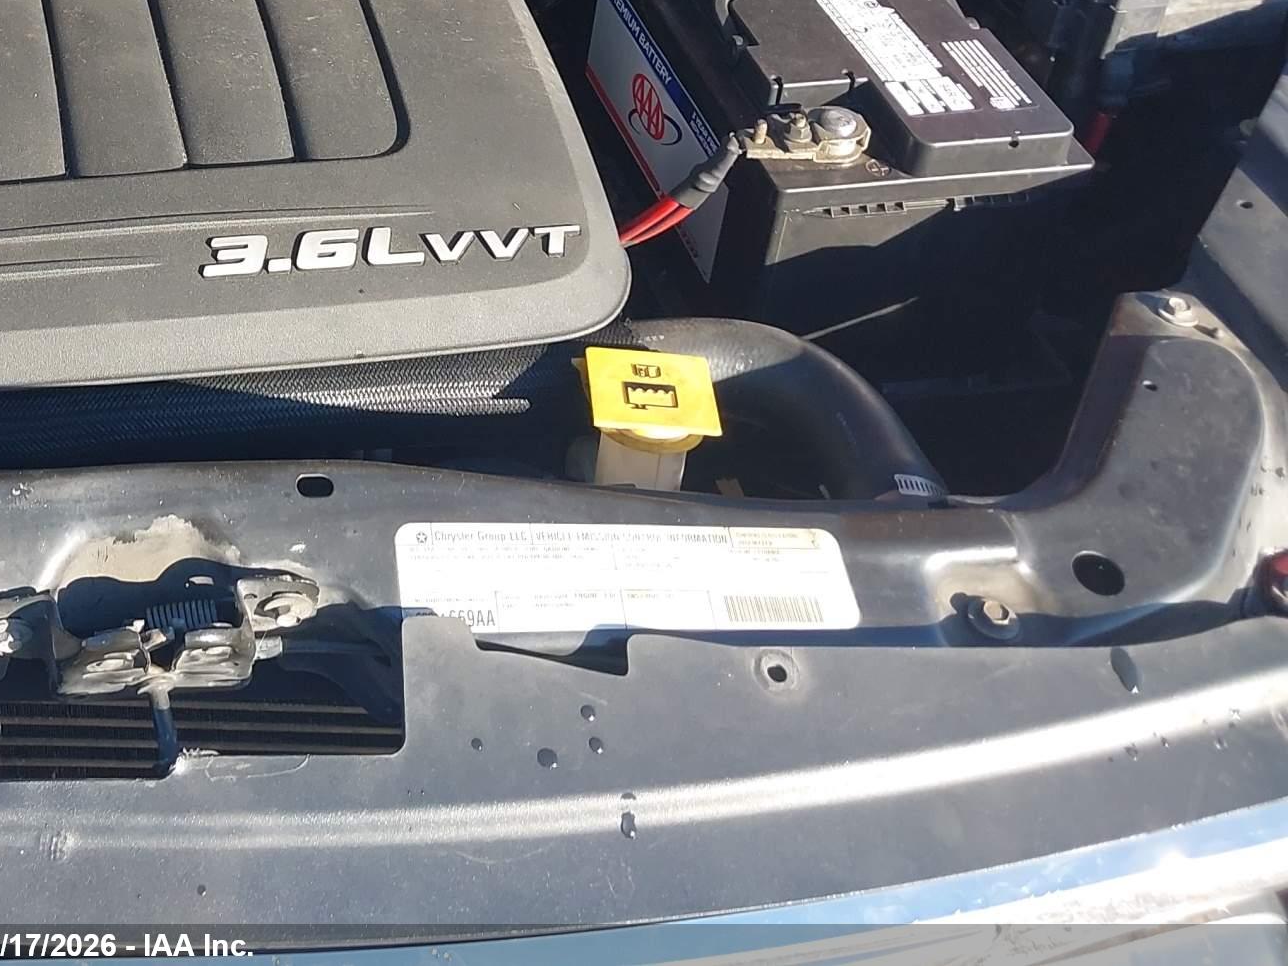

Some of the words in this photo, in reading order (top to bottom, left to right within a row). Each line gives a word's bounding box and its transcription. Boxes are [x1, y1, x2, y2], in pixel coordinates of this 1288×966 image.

[638, 30, 672, 86] BATTERY
[635, 77, 663, 140] AAA
[434, 530, 473, 543] Chrysler
[477, 531, 506, 543] Group
[509, 531, 527, 541] LLC
